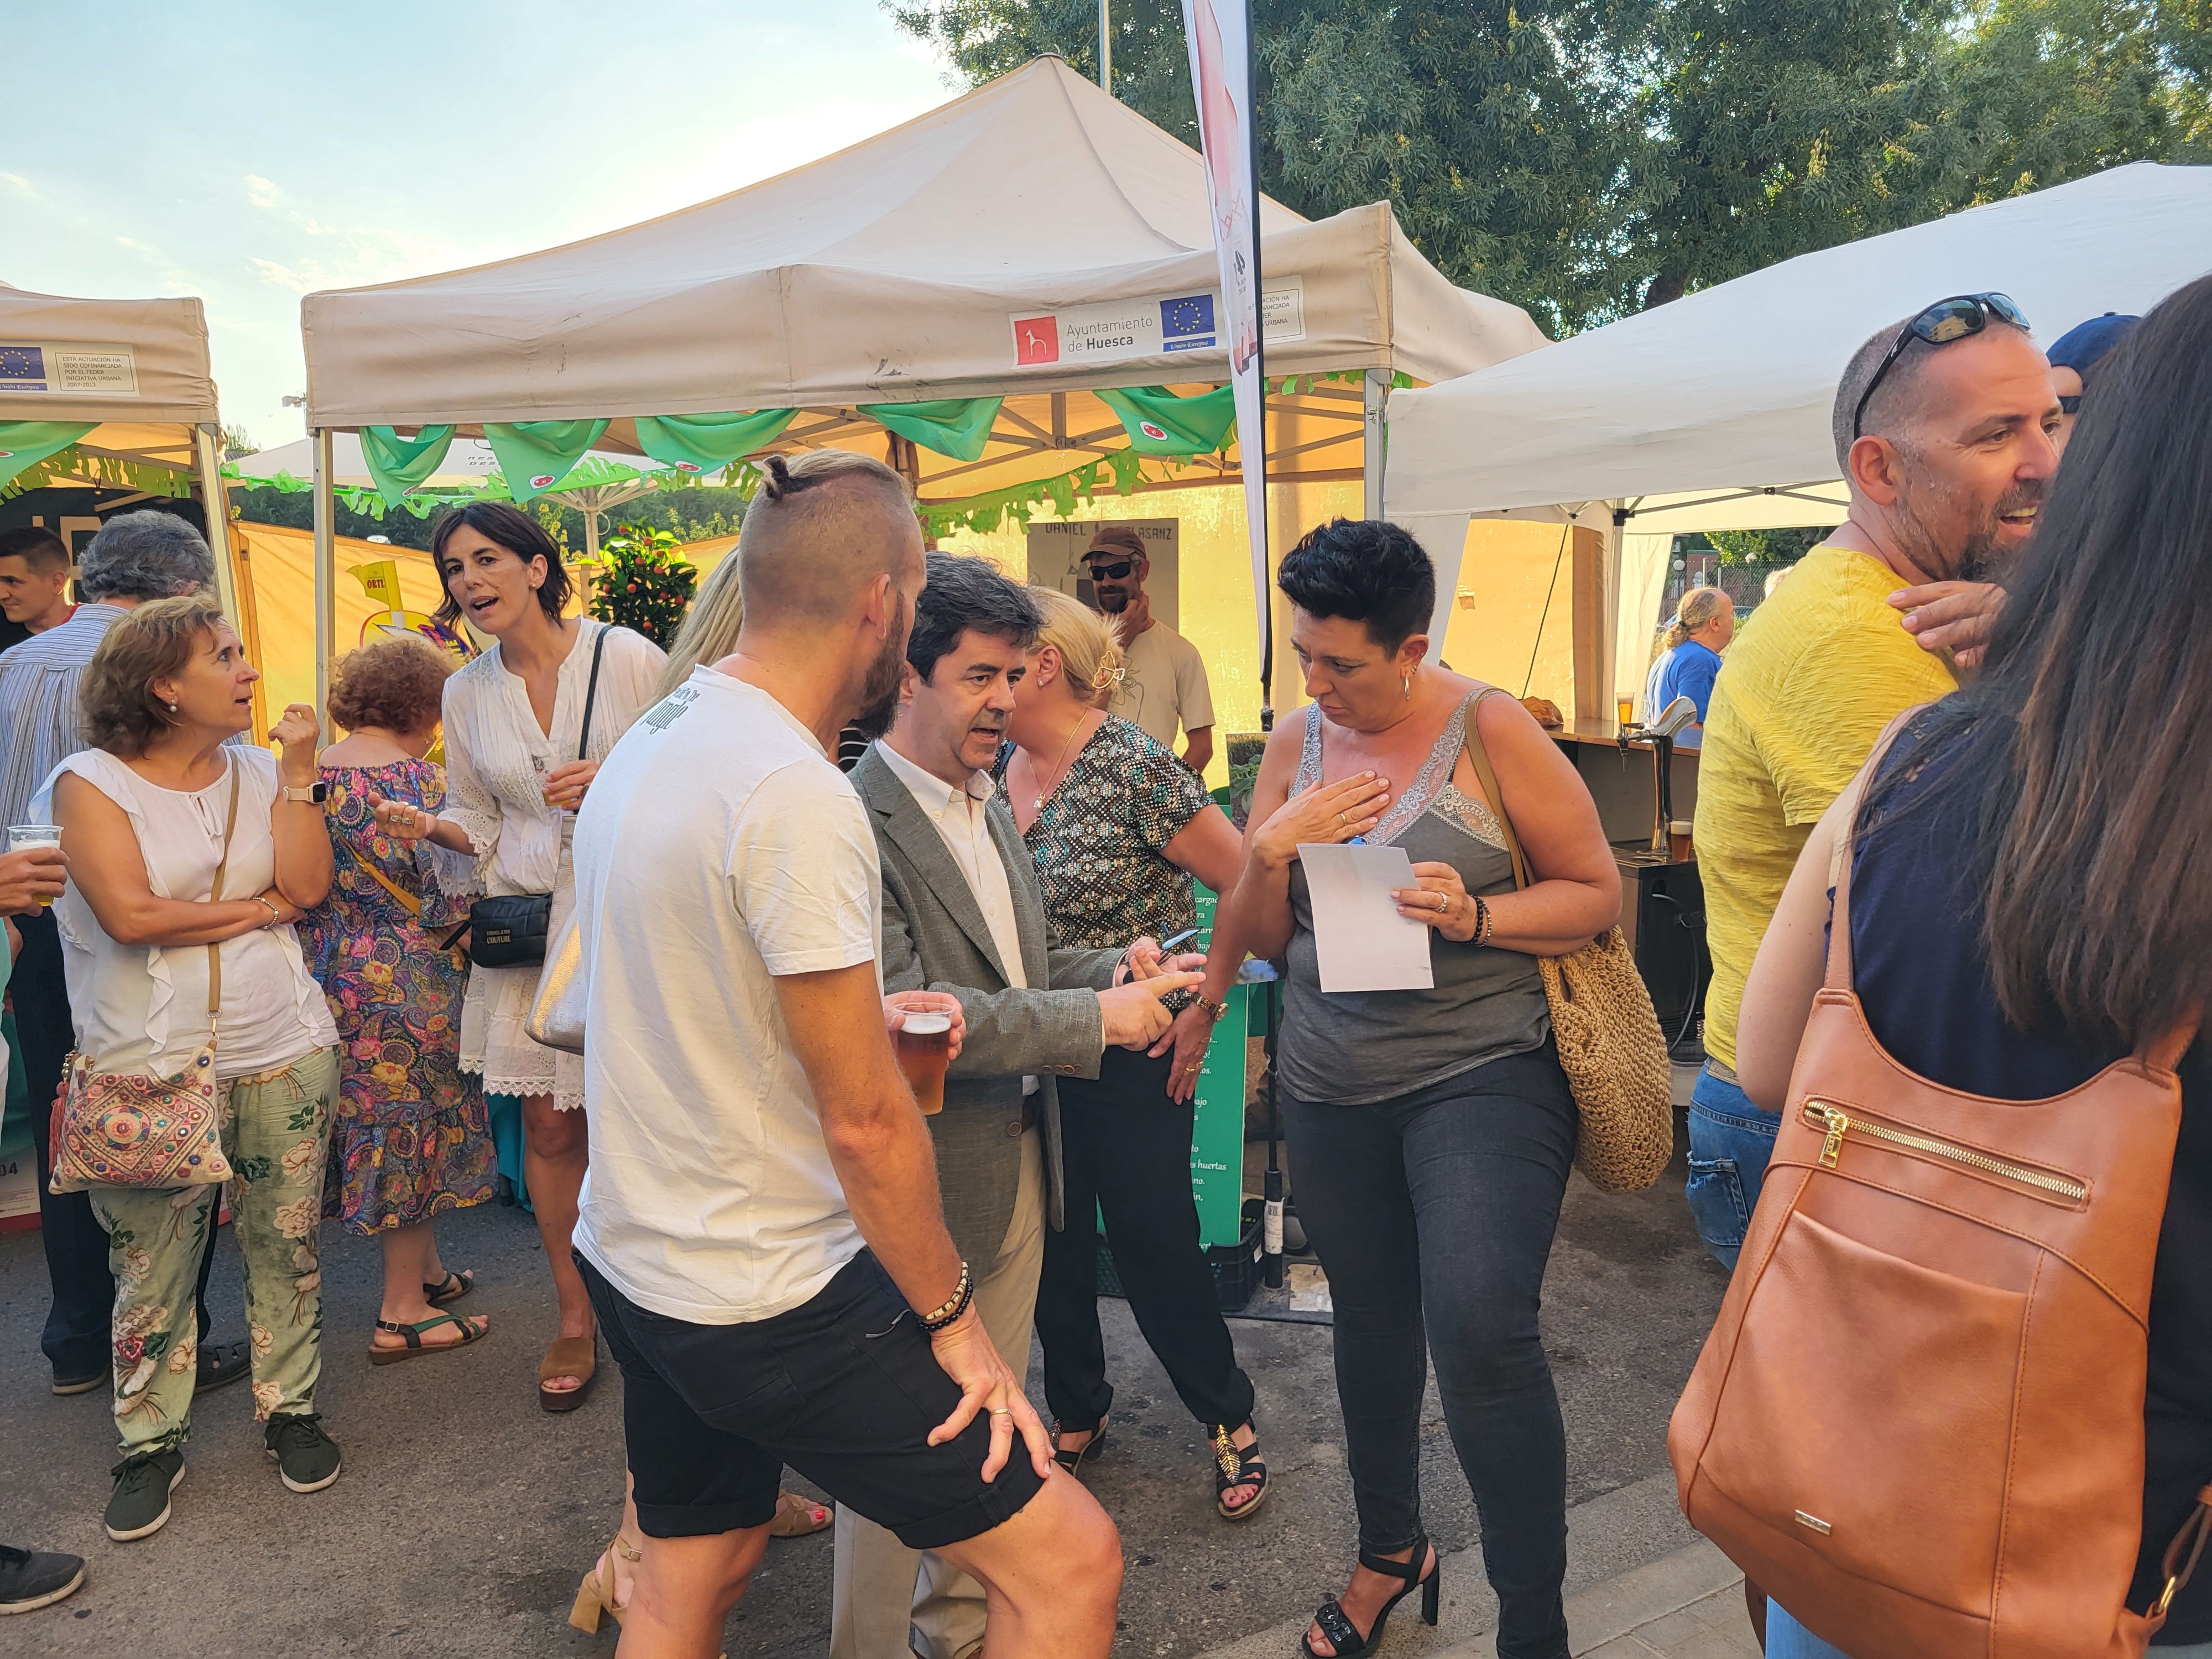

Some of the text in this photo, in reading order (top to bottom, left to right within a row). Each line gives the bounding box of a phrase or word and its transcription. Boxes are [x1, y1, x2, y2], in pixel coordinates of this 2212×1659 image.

[1066, 316, 1153, 339] Ayuntamiento
[1265, 318, 1288, 326] URBANA
[1068, 336, 1134, 352] de Huesca
[1170, 340, 1209, 350] Unión Europea
[1046, 523, 1087, 536] DANIEL
[487, 935, 512, 945] COUTURE
[1197, 1159, 1227, 1171] huertas
